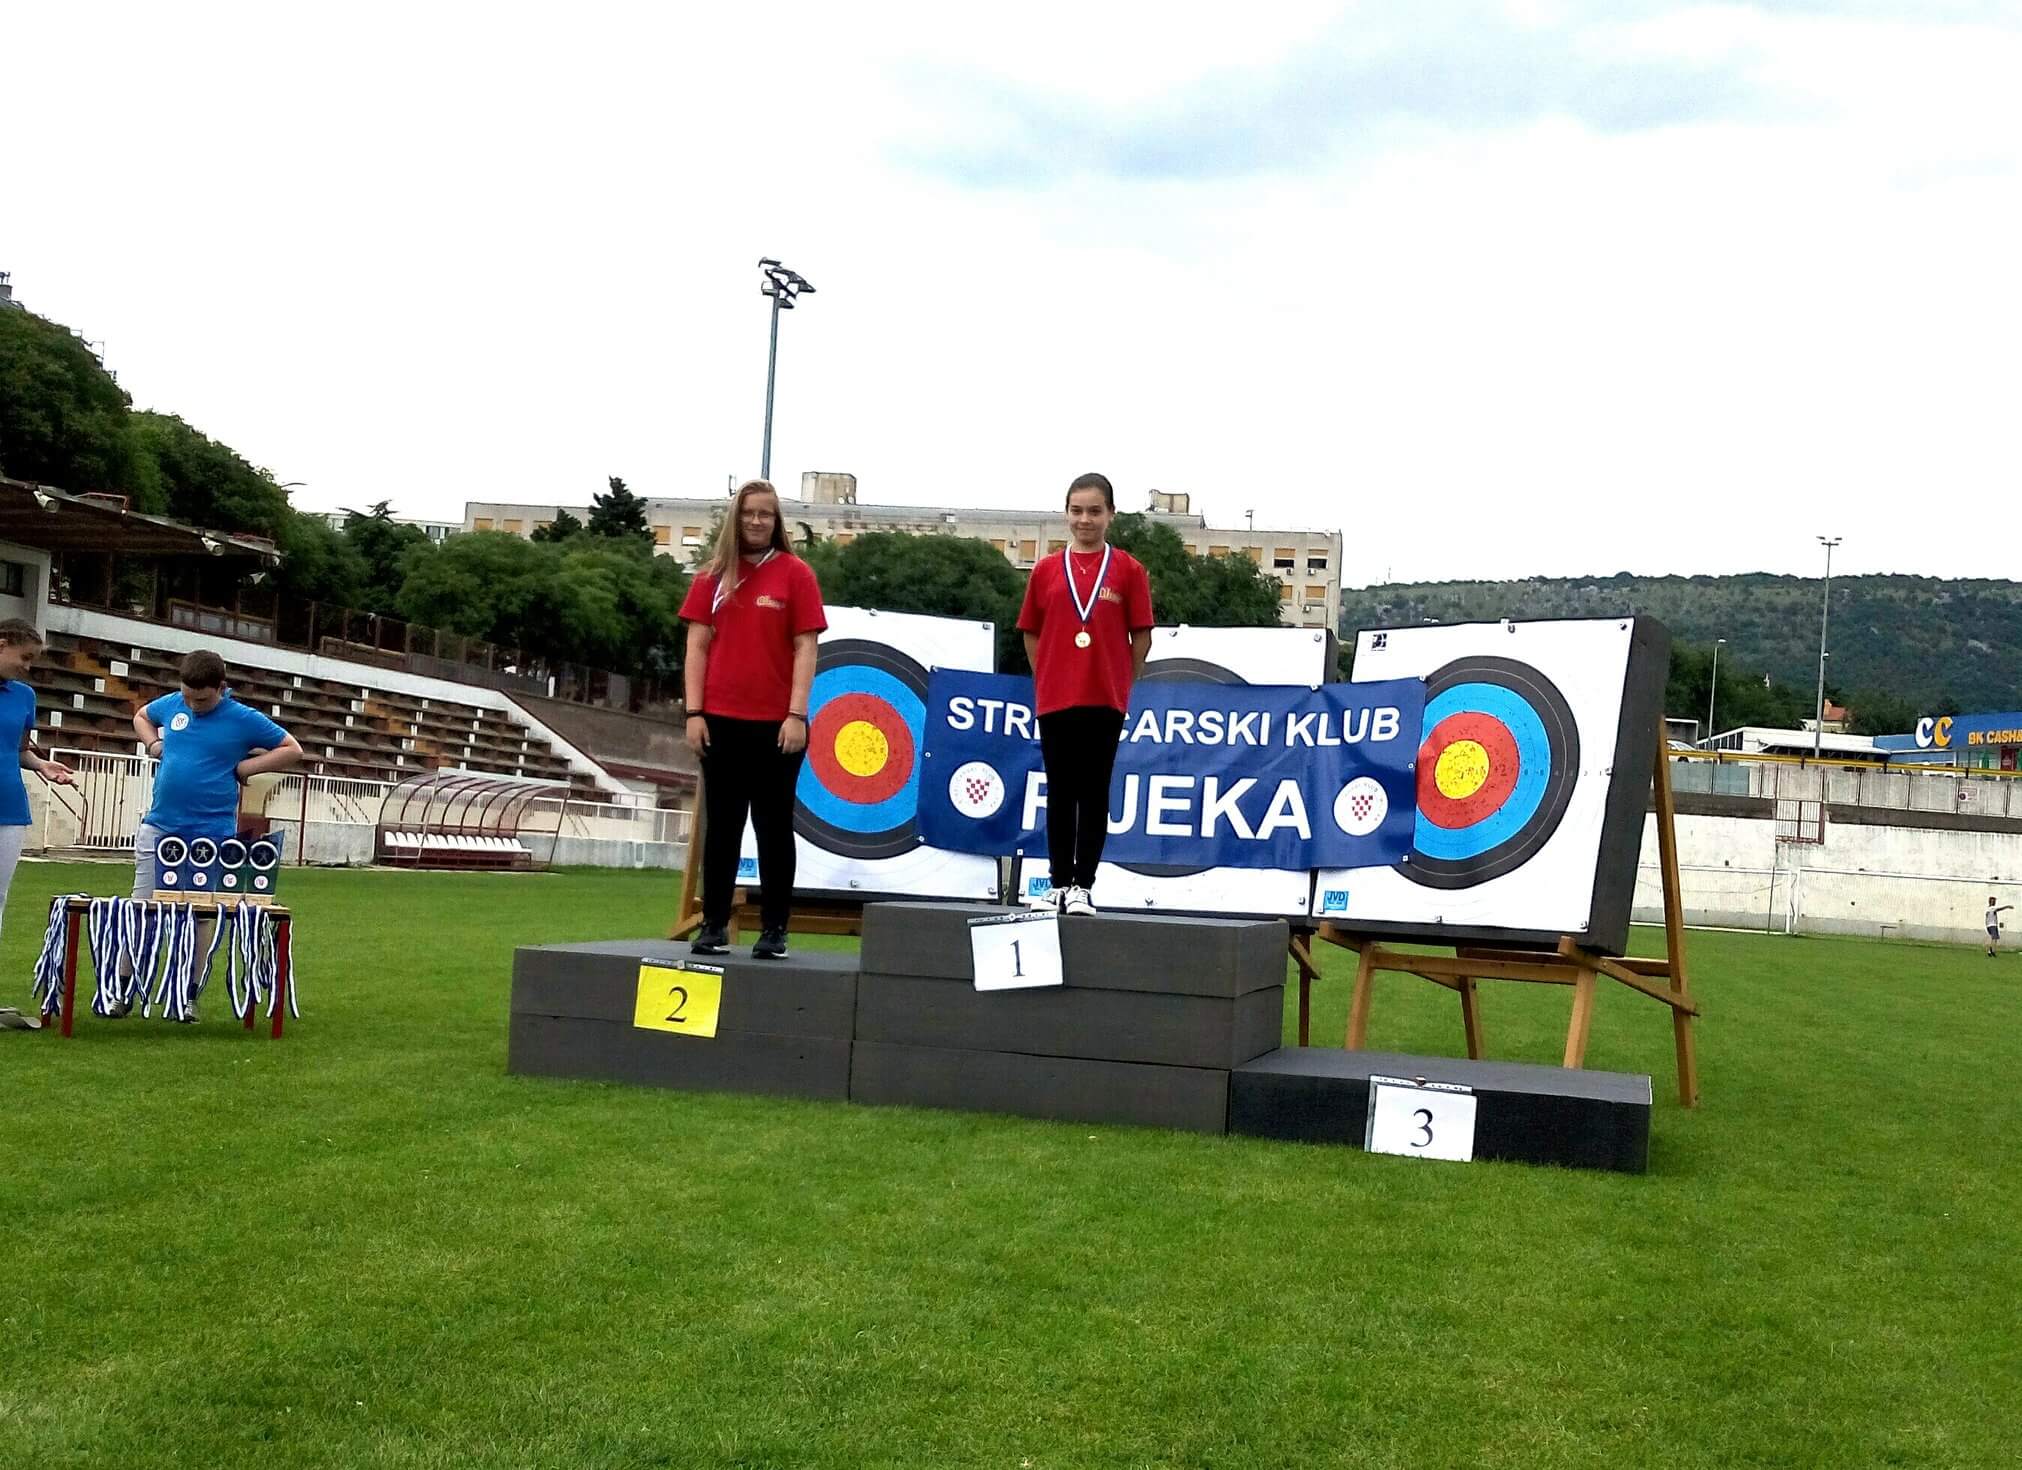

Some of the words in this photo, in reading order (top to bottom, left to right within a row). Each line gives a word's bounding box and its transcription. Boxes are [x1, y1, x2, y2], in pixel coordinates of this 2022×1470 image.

[946, 696, 1271, 745] STRARSKI
[1285, 706, 1400, 747] KLUB
[1915, 716, 1953, 748] CC
[1021, 770, 1312, 840] JEKA
[1326, 891, 1346, 902] JVD
[1009, 939, 1026, 978] 1
[664, 986, 688, 1023] 2
[1410, 1108, 1433, 1148] 3
